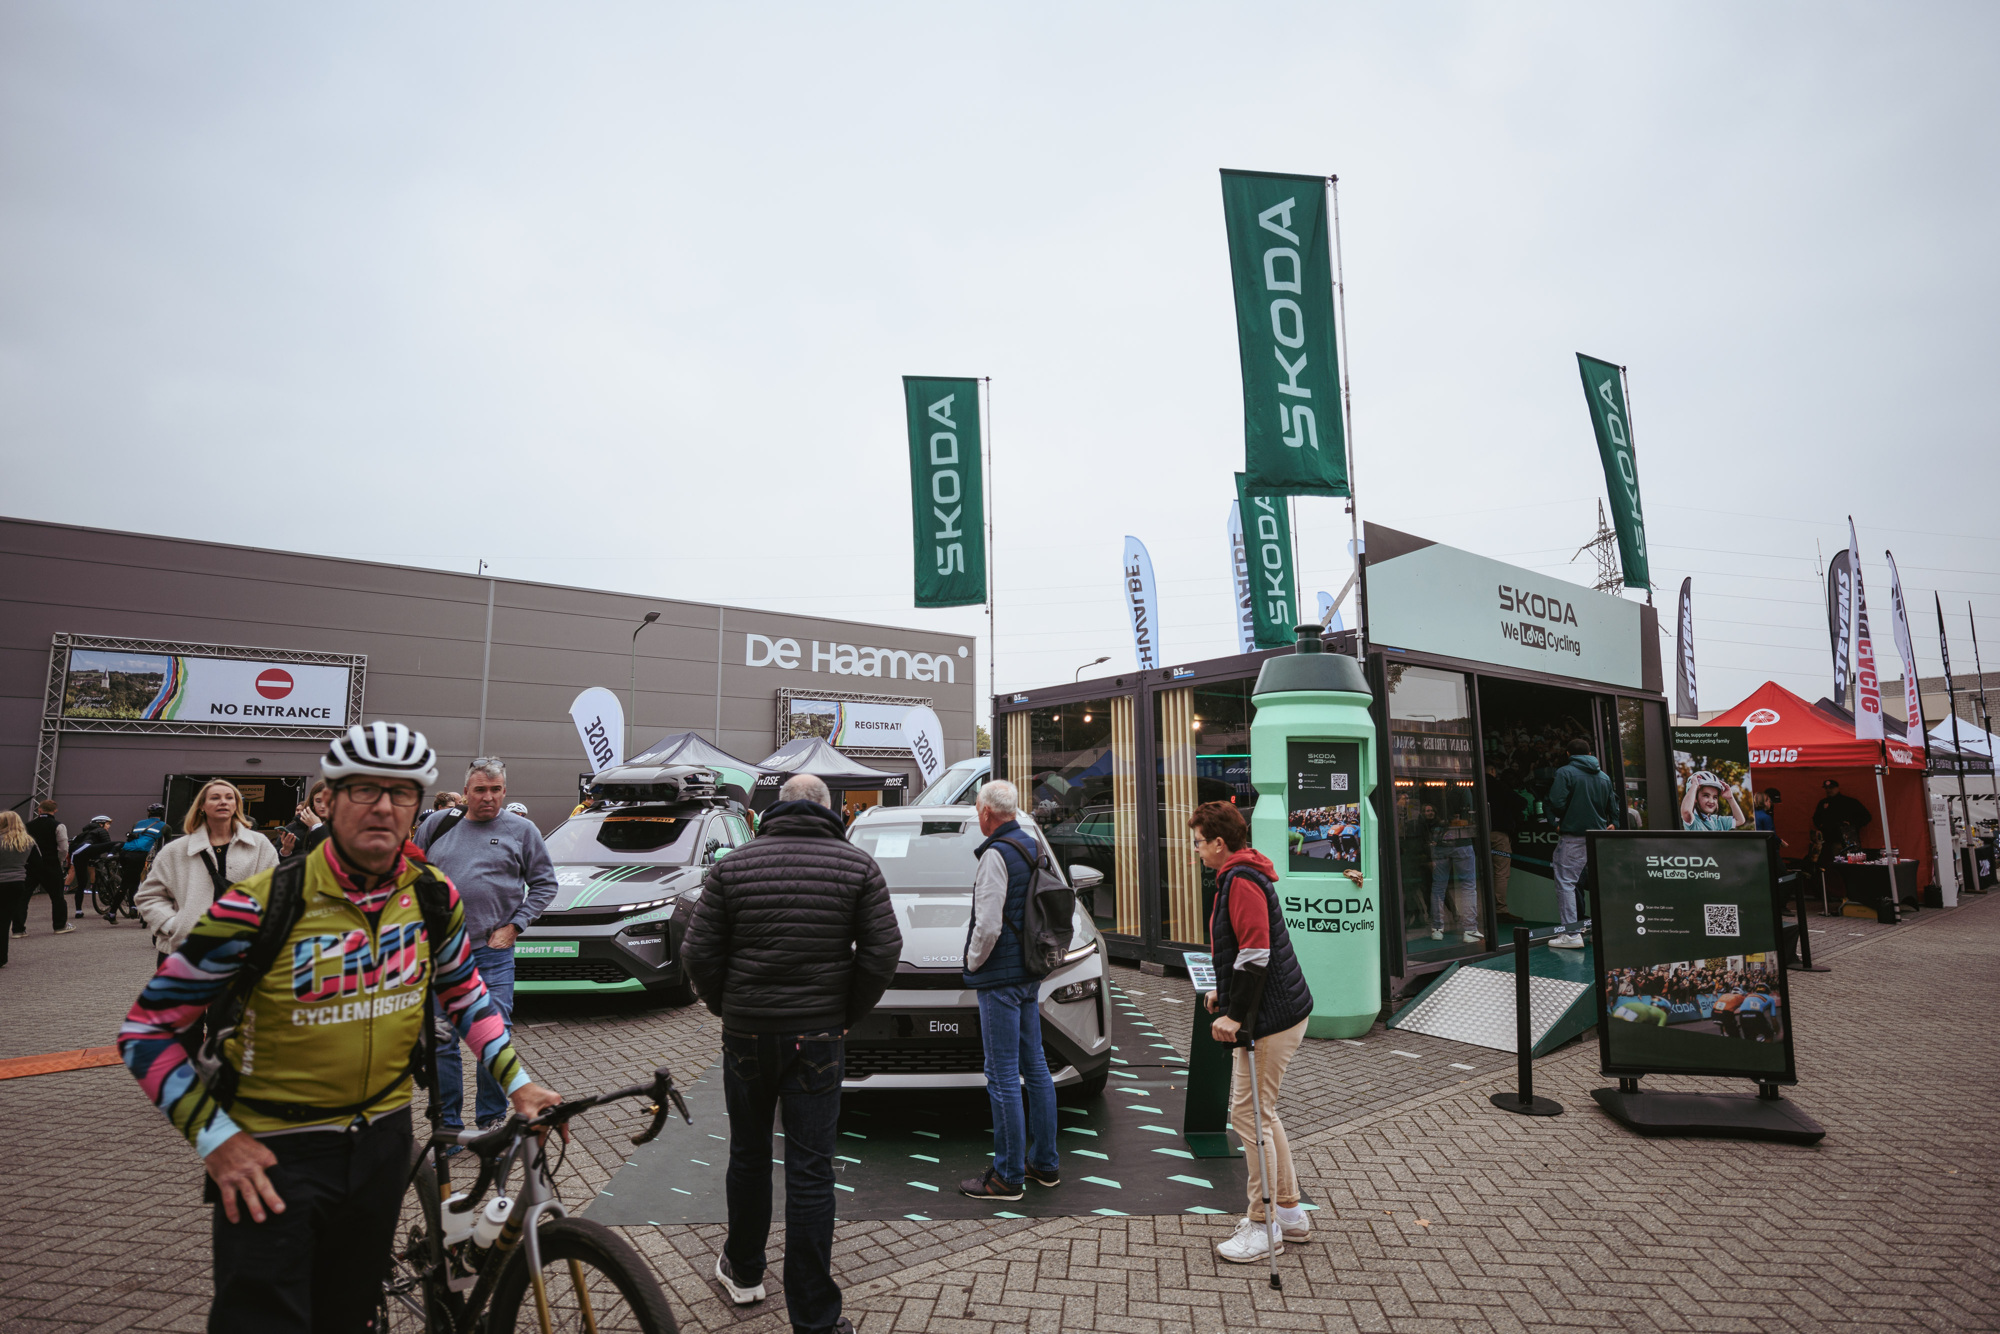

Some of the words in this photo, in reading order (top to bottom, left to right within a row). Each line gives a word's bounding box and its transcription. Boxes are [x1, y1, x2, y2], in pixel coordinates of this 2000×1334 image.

[1501, 621, 1519, 641] We
[1521, 624, 1545, 647] Love
[1547, 632, 1580, 656] Cycling
[745, 633, 801, 669] De
[812, 640, 955, 684] Haamen
[210, 703, 238, 715] NO
[243, 704, 331, 719] ENTRANCE
[854, 720, 902, 731] REGISTRATI
[884, 777, 904, 786] ROSE
[1518, 832, 1560, 844] SKO
[1647, 870, 1663, 878] We
[1665, 870, 1686, 878] Love
[1688, 870, 1721, 880] Cycling
[1285, 918, 1305, 929] We
[1309, 919, 1338, 931] Love
[1342, 919, 1375, 933] Cycling
[514, 946, 551, 954] URIOSITY
[292, 920, 431, 1004] CMC
[291, 987, 424, 1027] CYCLEMEISTERS
[929, 1020, 959, 1034] Elroq
